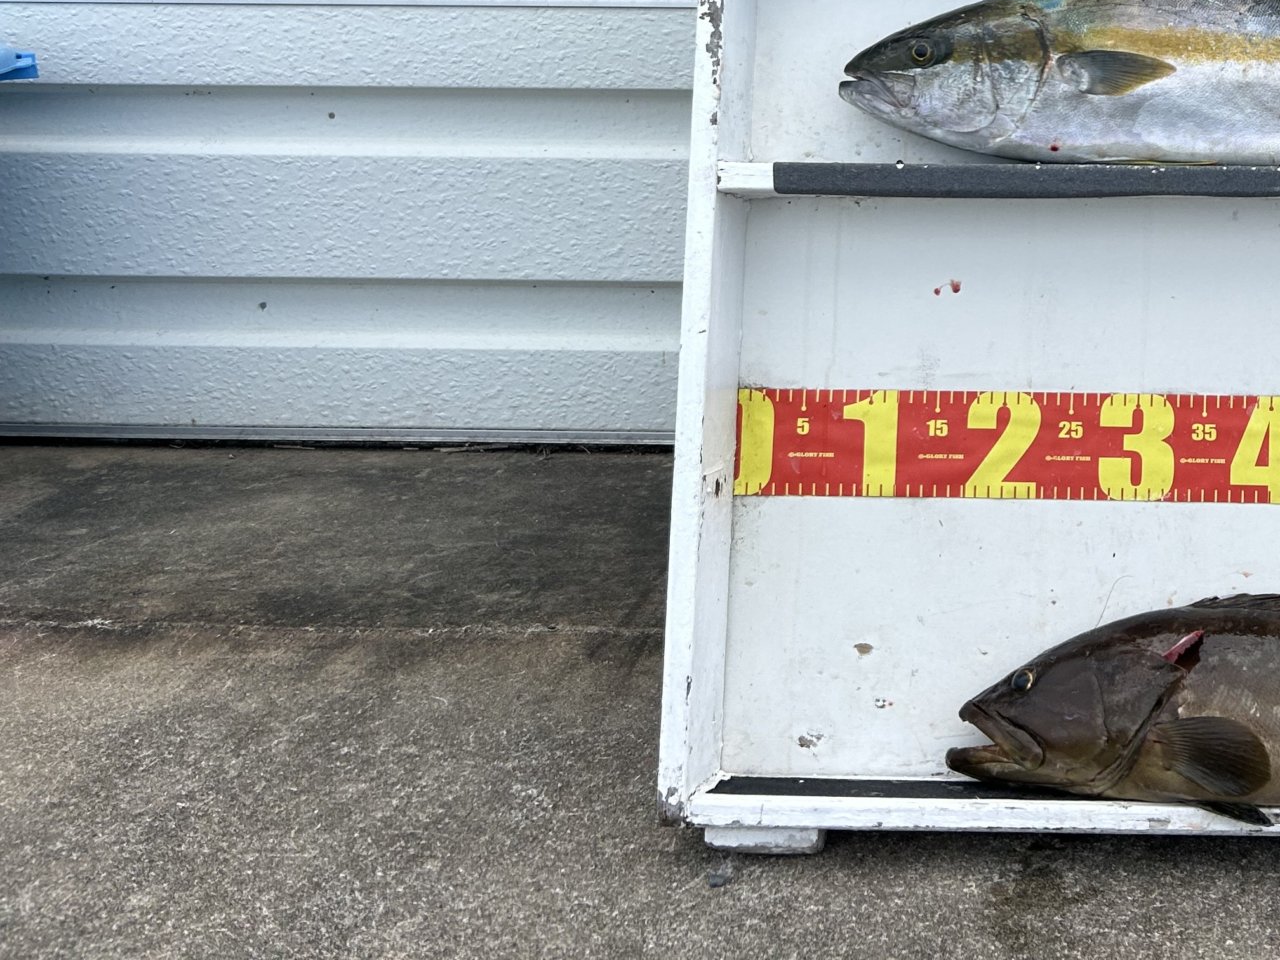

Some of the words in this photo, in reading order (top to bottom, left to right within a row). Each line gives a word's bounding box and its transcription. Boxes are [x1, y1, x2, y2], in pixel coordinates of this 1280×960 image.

[797, 418, 810, 435] 5
[843, 390, 899, 497] 1
[926, 419, 949, 437] 15
[965, 392, 1041, 499] 2
[1058, 421, 1083, 439] 25
[1098, 394, 1175, 501] 3
[1191, 424, 1217, 441] 35
